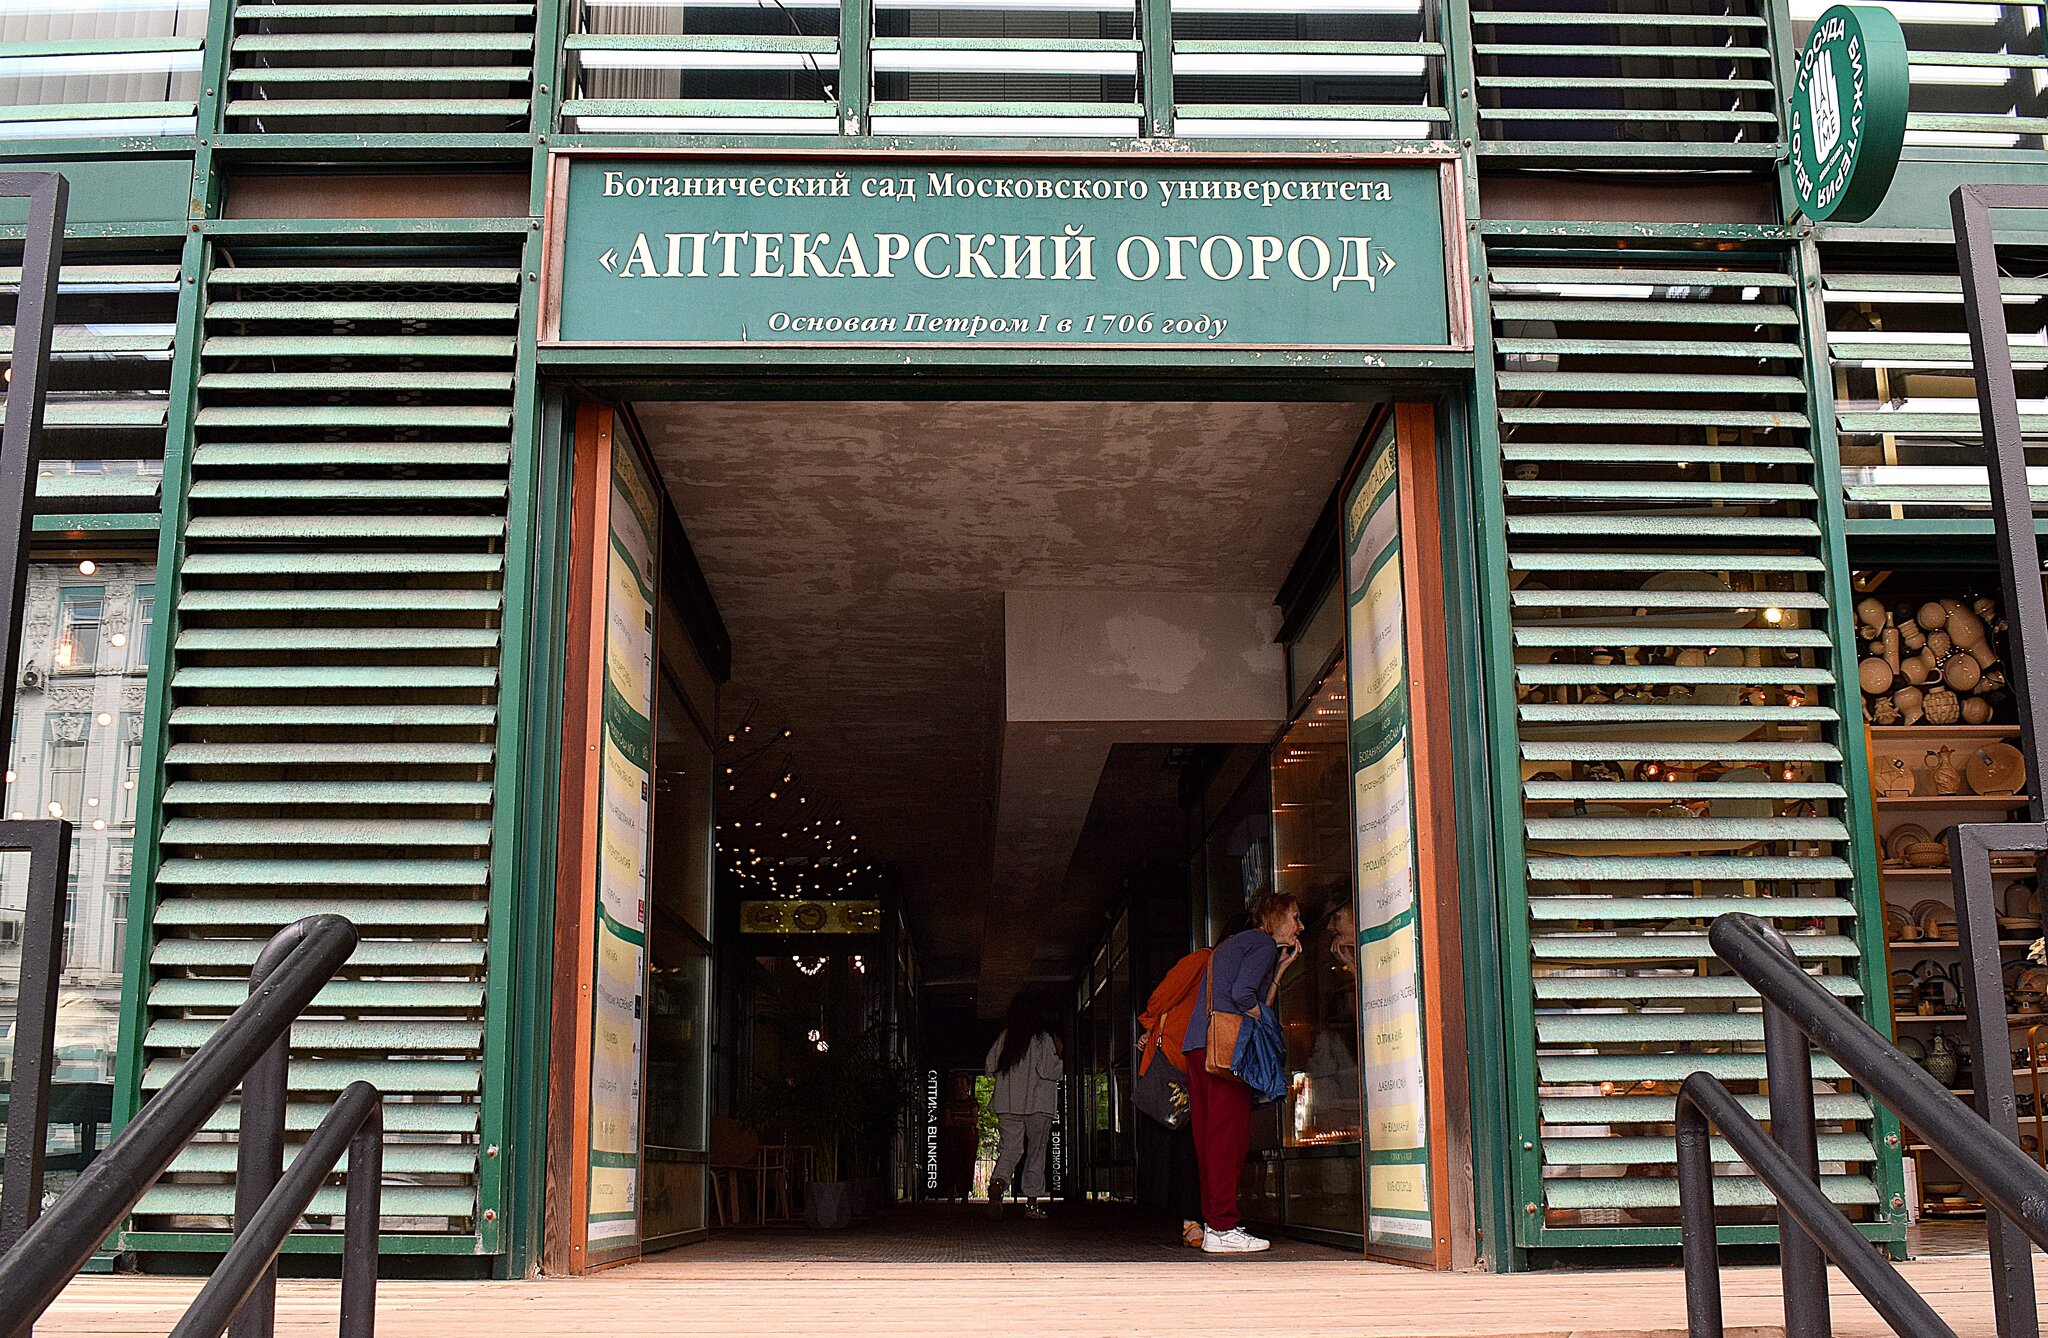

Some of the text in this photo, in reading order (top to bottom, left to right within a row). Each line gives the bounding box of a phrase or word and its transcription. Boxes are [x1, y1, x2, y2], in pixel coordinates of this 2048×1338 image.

[1798, 17, 1845, 92] ПОСУДА
[1792, 110, 1814, 202] ДЕКОР
[1817, 34, 1864, 209] БИЖУТЕРИЯ
[602, 171, 1393, 207] Ботанический сад Московского университета
[598, 224, 1397, 292] «АПТЕКАРСКИЙ ОГОРОД»
[768, 312, 1228, 340] Основан Петром I в 1706 году
[927, 1069, 938, 1189] ОПТИКА BLINKERS
[1052, 1131, 1061, 1191] МОРОЖЕНОЕ
